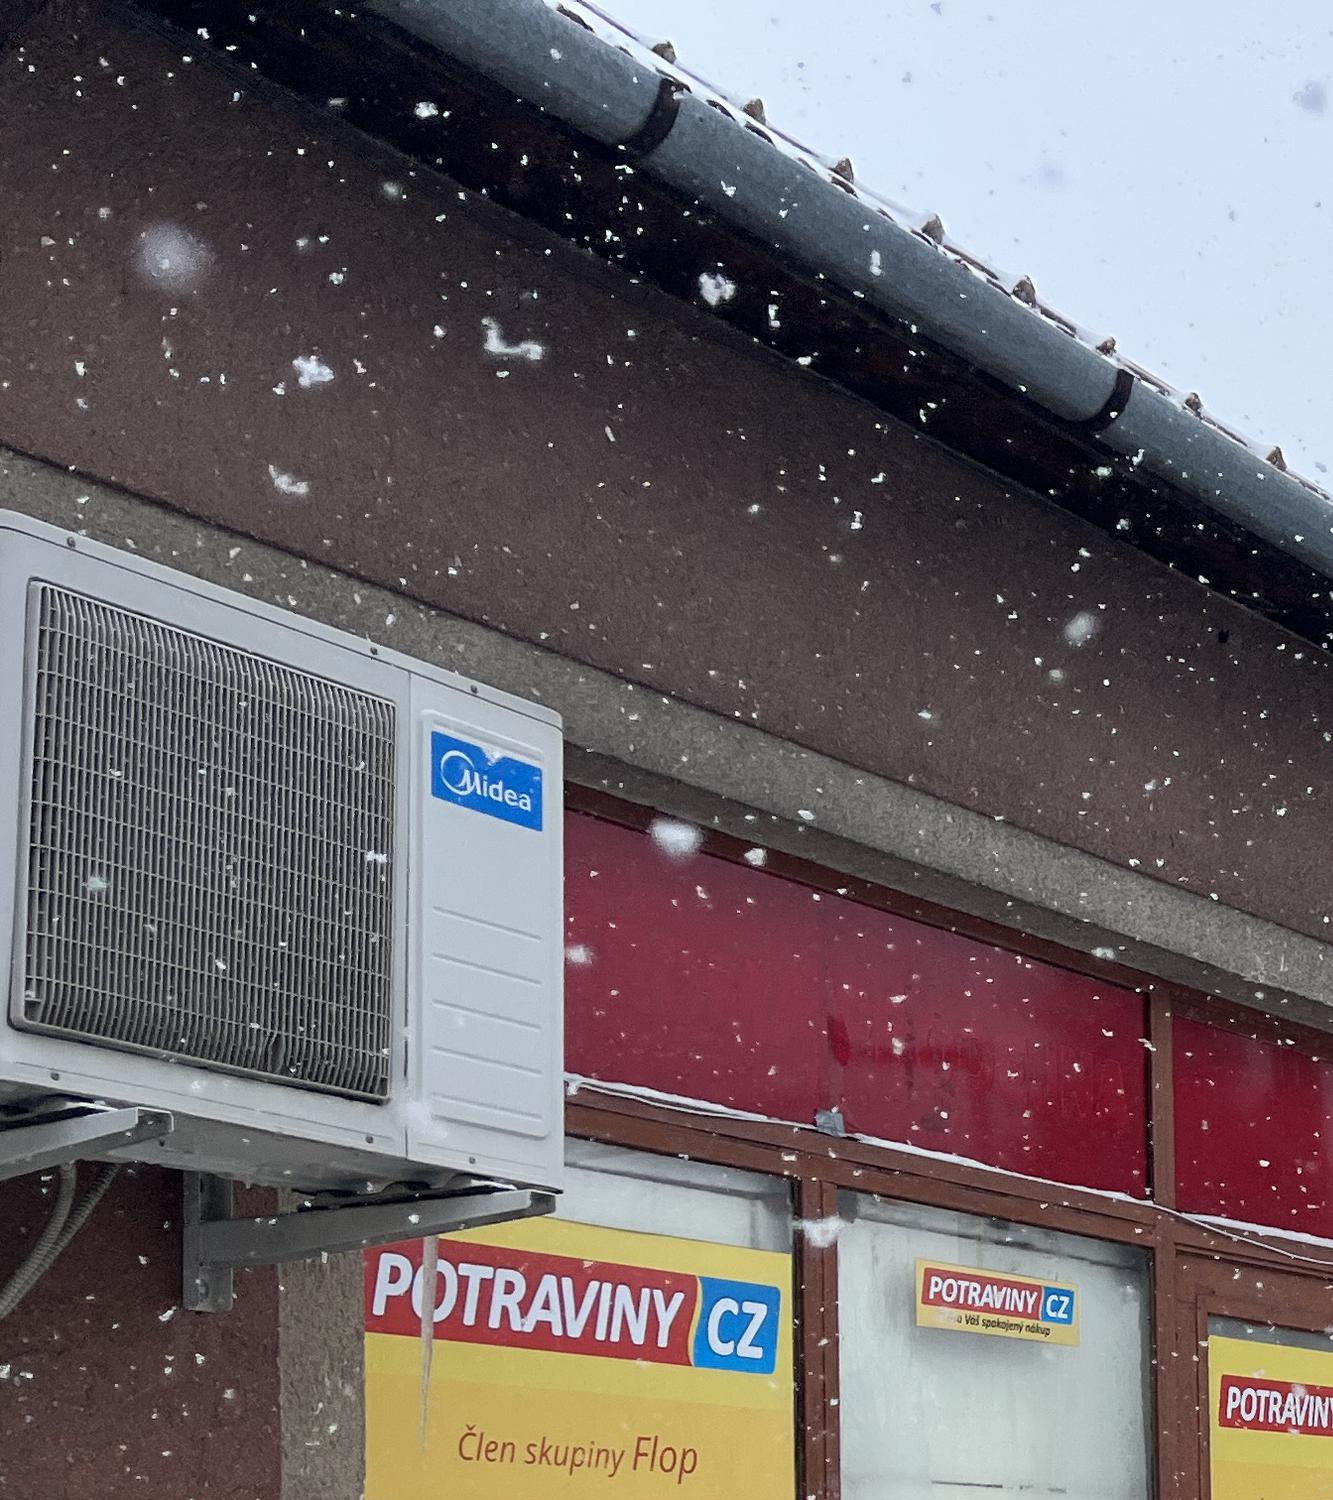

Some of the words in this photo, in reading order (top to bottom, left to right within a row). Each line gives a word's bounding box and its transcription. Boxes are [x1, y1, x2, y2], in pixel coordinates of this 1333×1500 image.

[441, 750, 531, 811] Midea
[371, 1252, 685, 1349] POTRAVINY
[707, 1297, 768, 1359] CZ
[929, 1276, 1038, 1314] POTRAVINY
[1046, 1295, 1070, 1318] CZ
[965, 1313, 980, 1326] Váš
[982, 1317, 1024, 1333] spokojený
[1025, 1323, 1050, 1337] nákup
[459, 1423, 516, 1464] Člen
[524, 1434, 626, 1478] skupiny
[633, 1435, 698, 1485] Flop
